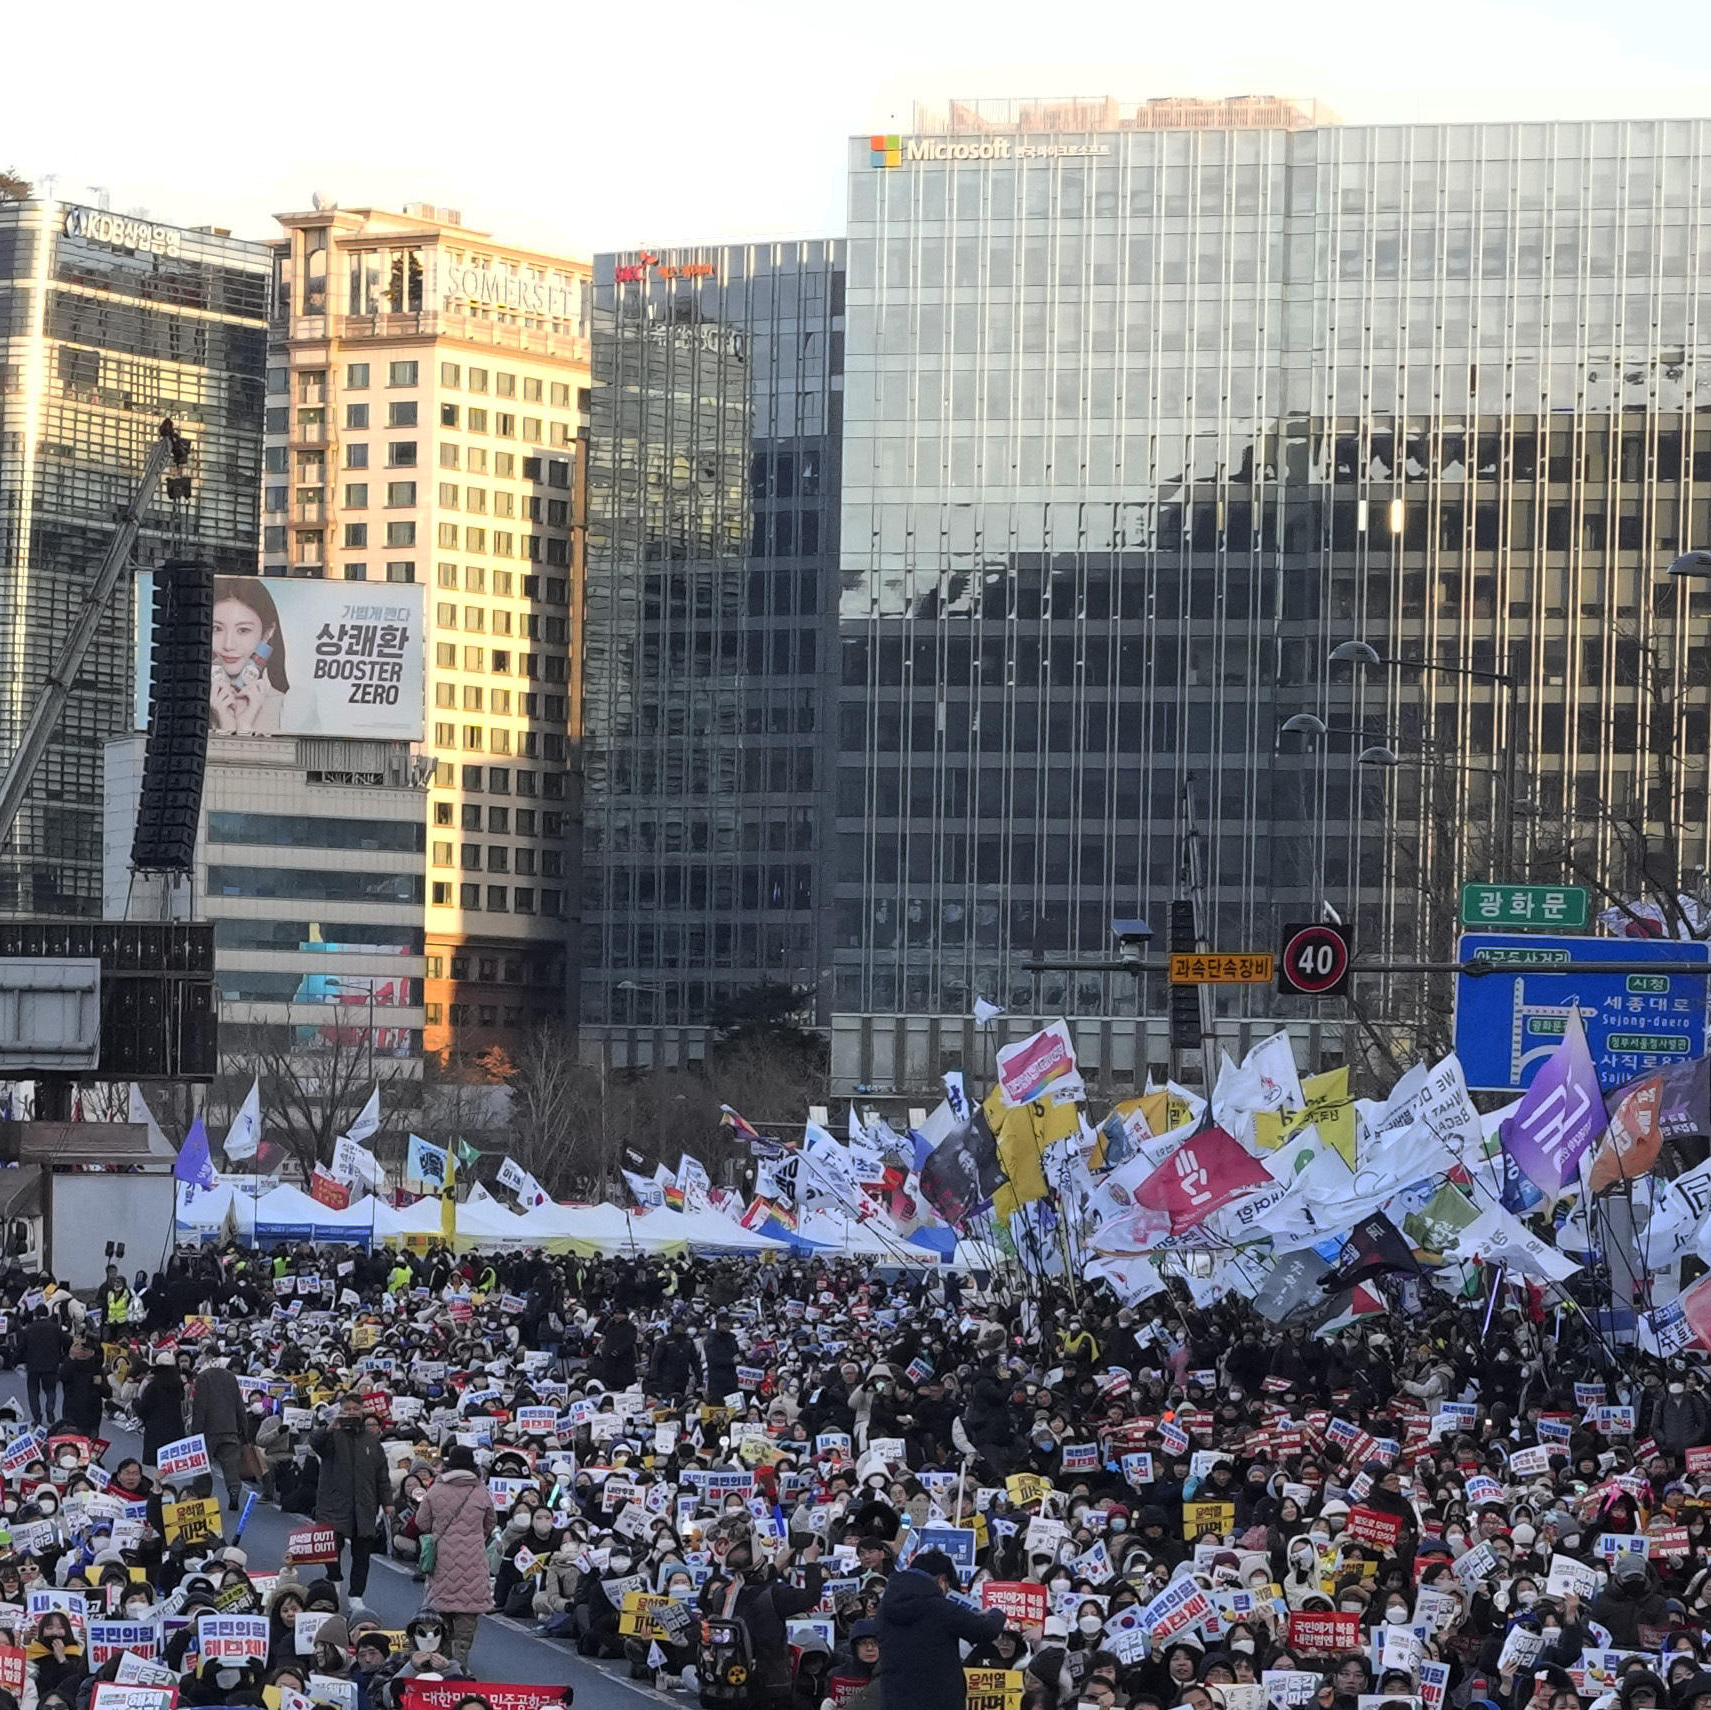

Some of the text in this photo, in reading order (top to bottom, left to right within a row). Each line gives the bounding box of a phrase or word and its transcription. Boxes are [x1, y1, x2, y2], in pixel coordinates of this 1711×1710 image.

[906, 137, 1011, 161] Microsoft
[449, 264, 573, 314] SOMERSET
[315, 622, 409, 659] 상쾌환
[313, 658, 403, 684] BOOSTER
[348, 682, 399, 706] ZERO
[1478, 891, 1569, 920] 광화문
[1175, 957, 1270, 980] 과속단속장비
[1298, 944, 1333, 975] 40
[1603, 995, 1691, 1014] 세종대로
[1602, 1013, 1690, 1029] Sejong-daero
